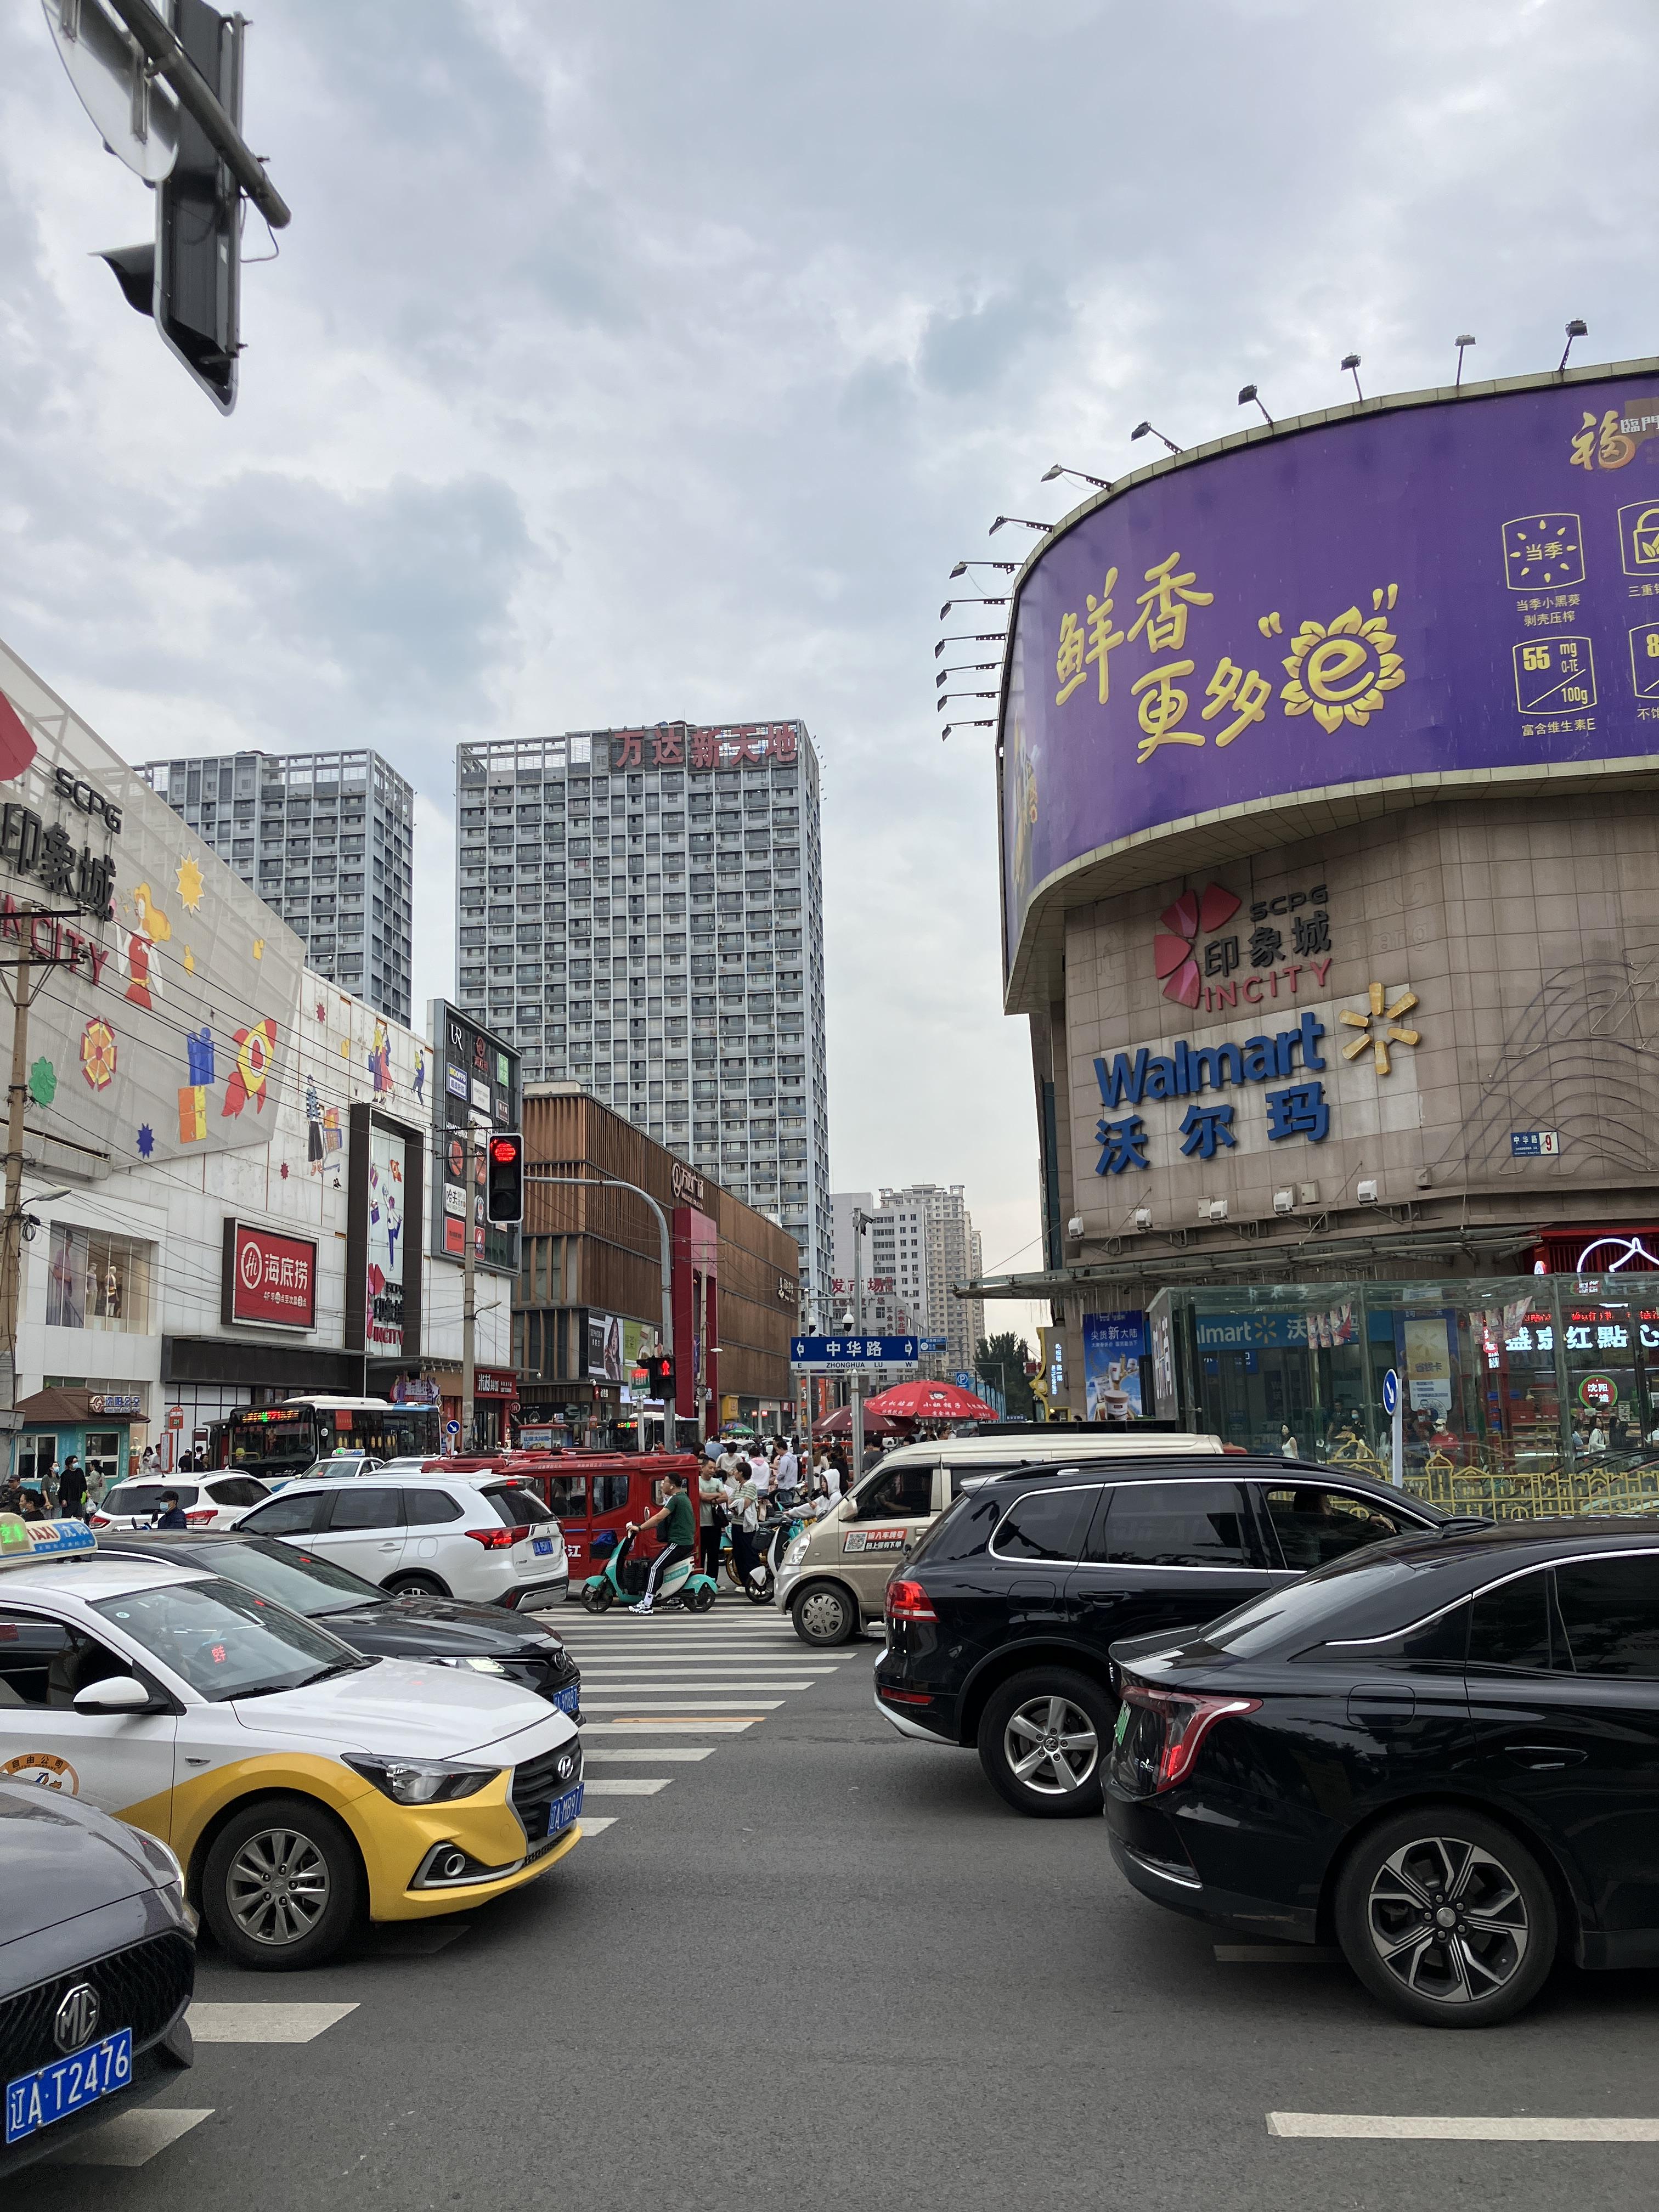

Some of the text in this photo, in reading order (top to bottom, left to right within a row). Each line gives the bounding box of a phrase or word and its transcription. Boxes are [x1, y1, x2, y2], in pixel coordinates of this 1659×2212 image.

[1620, 415, 1659, 434] 臨門
[1526, 541, 1563, 561] 当季
[1516, 594, 1581, 612] 当季小黑葵
[1524, 611, 1576, 627] 剥壳压榨
[1522, 642, 1577, 671] 55 mg
[1561, 686, 1588, 704] 100g
[1522, 718, 1596, 736] 富含维生素E
[614, 722, 798, 768] 万达新天地
[55, 767, 123, 834] SCPG
[0, 803, 116, 922] 印象城
[1250, 884, 1328, 922] SCPG
[0, 892, 109, 986] NCITY
[1204, 910, 1332, 978] 印象城
[1204, 958, 1332, 1012] INCITY
[451, 1024, 464, 1051] UR
[1093, 1012, 1326, 1108] Walmart
[1094, 1082, 1329, 1175] 沃尔玛
[1513, 1134, 1552, 1151] 中华路 9
[681, 1167, 703, 1200] 万达广场
[264, 1253, 308, 1290] 海底捞
[373, 1327, 404, 1345] INCITY
[1091, 1325, 1138, 1340] 尖货新大陆
[826, 1340, 882, 1357] 中华路
[1588, 1383, 1609, 1392] 沈阳
[60, 1524, 89, 1538] 沈阳
[565, 1545, 582, 1558] 江
[12, 1755, 64, 1769] 自由公司
[60, 1989, 97, 2046] MG
[10, 2039, 129, 2132] 辽A·T2476
